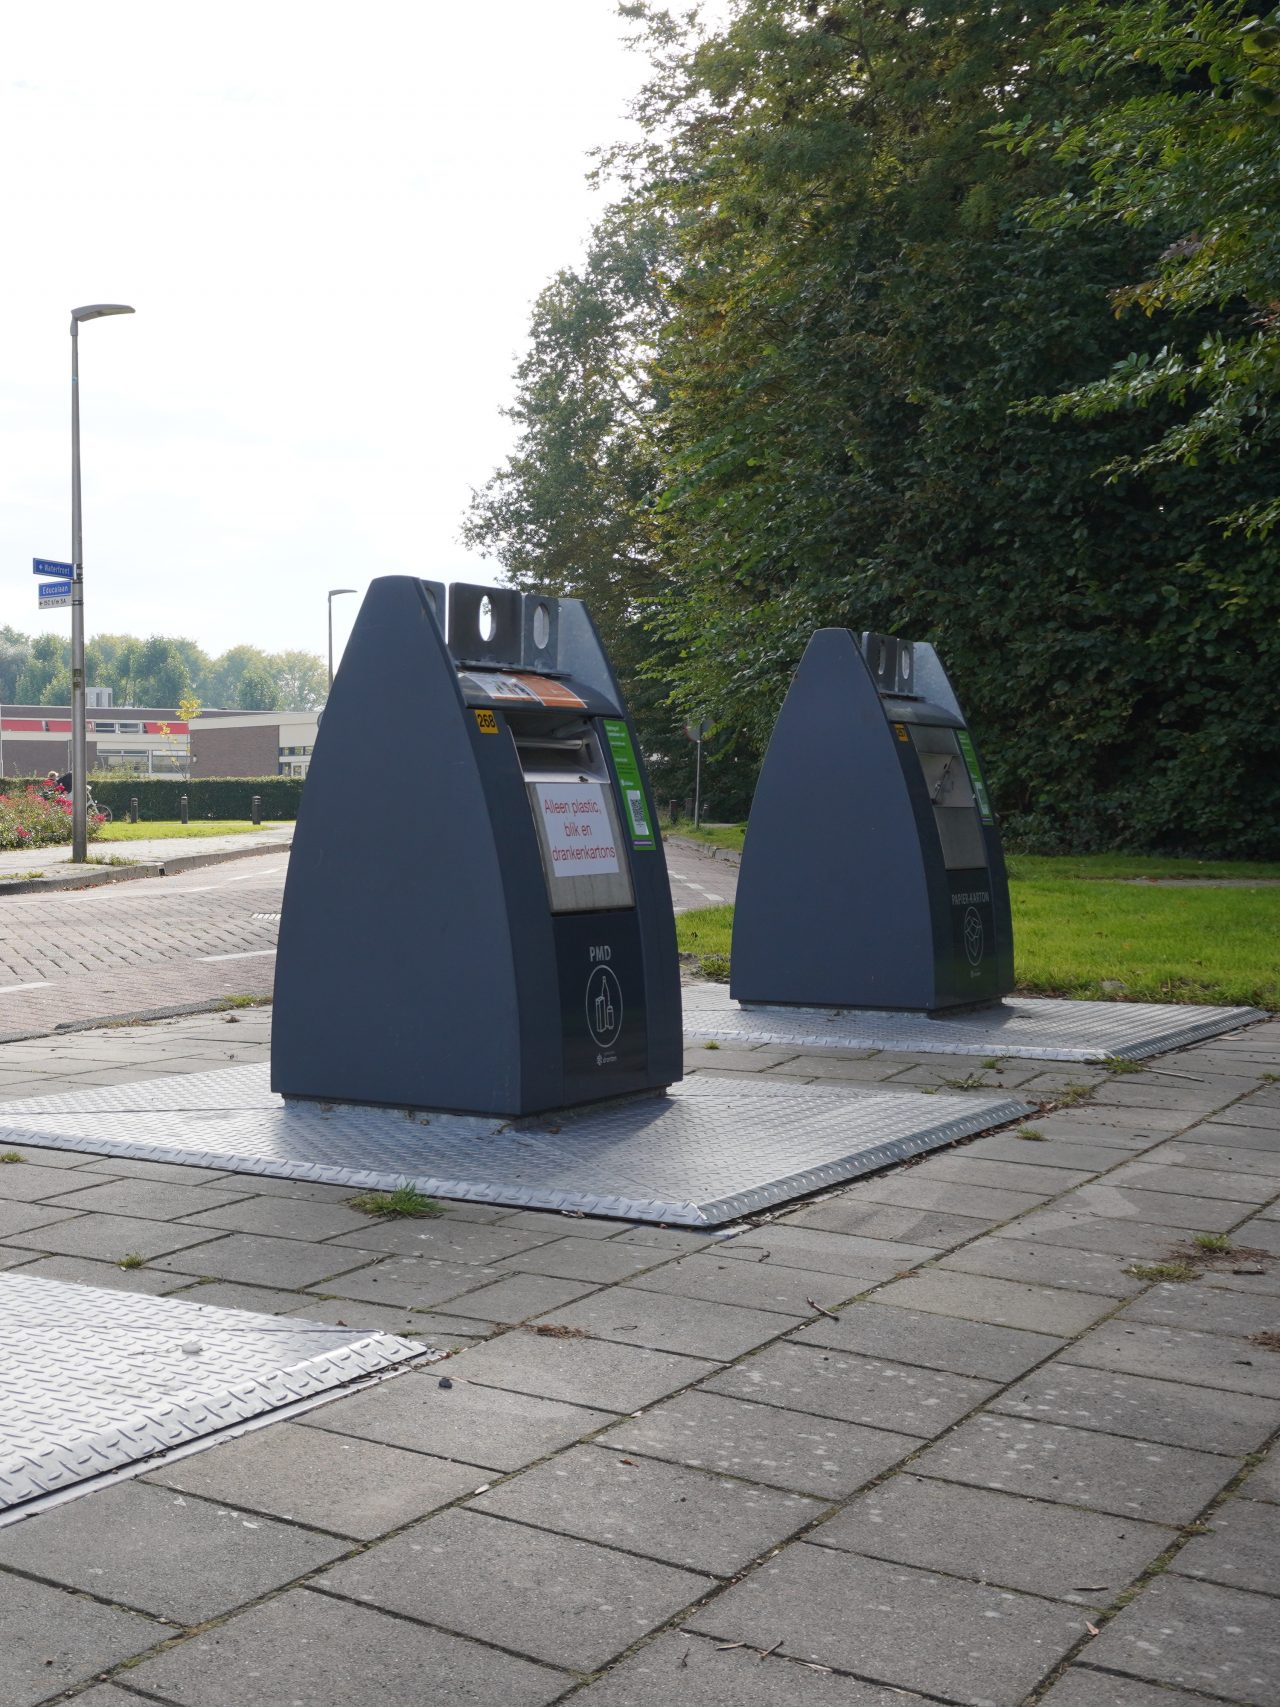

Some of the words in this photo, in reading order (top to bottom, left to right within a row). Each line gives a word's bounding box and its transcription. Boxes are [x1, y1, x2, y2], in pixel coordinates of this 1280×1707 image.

[477, 714, 496, 728] 268
[544, 799, 570, 814] Alleen
[571, 799, 602, 816] plastic,
[564, 822, 580, 837] blik
[581, 825, 593, 836] en
[552, 845, 616, 862] drankenkartons
[589, 945, 612, 962] PMD
